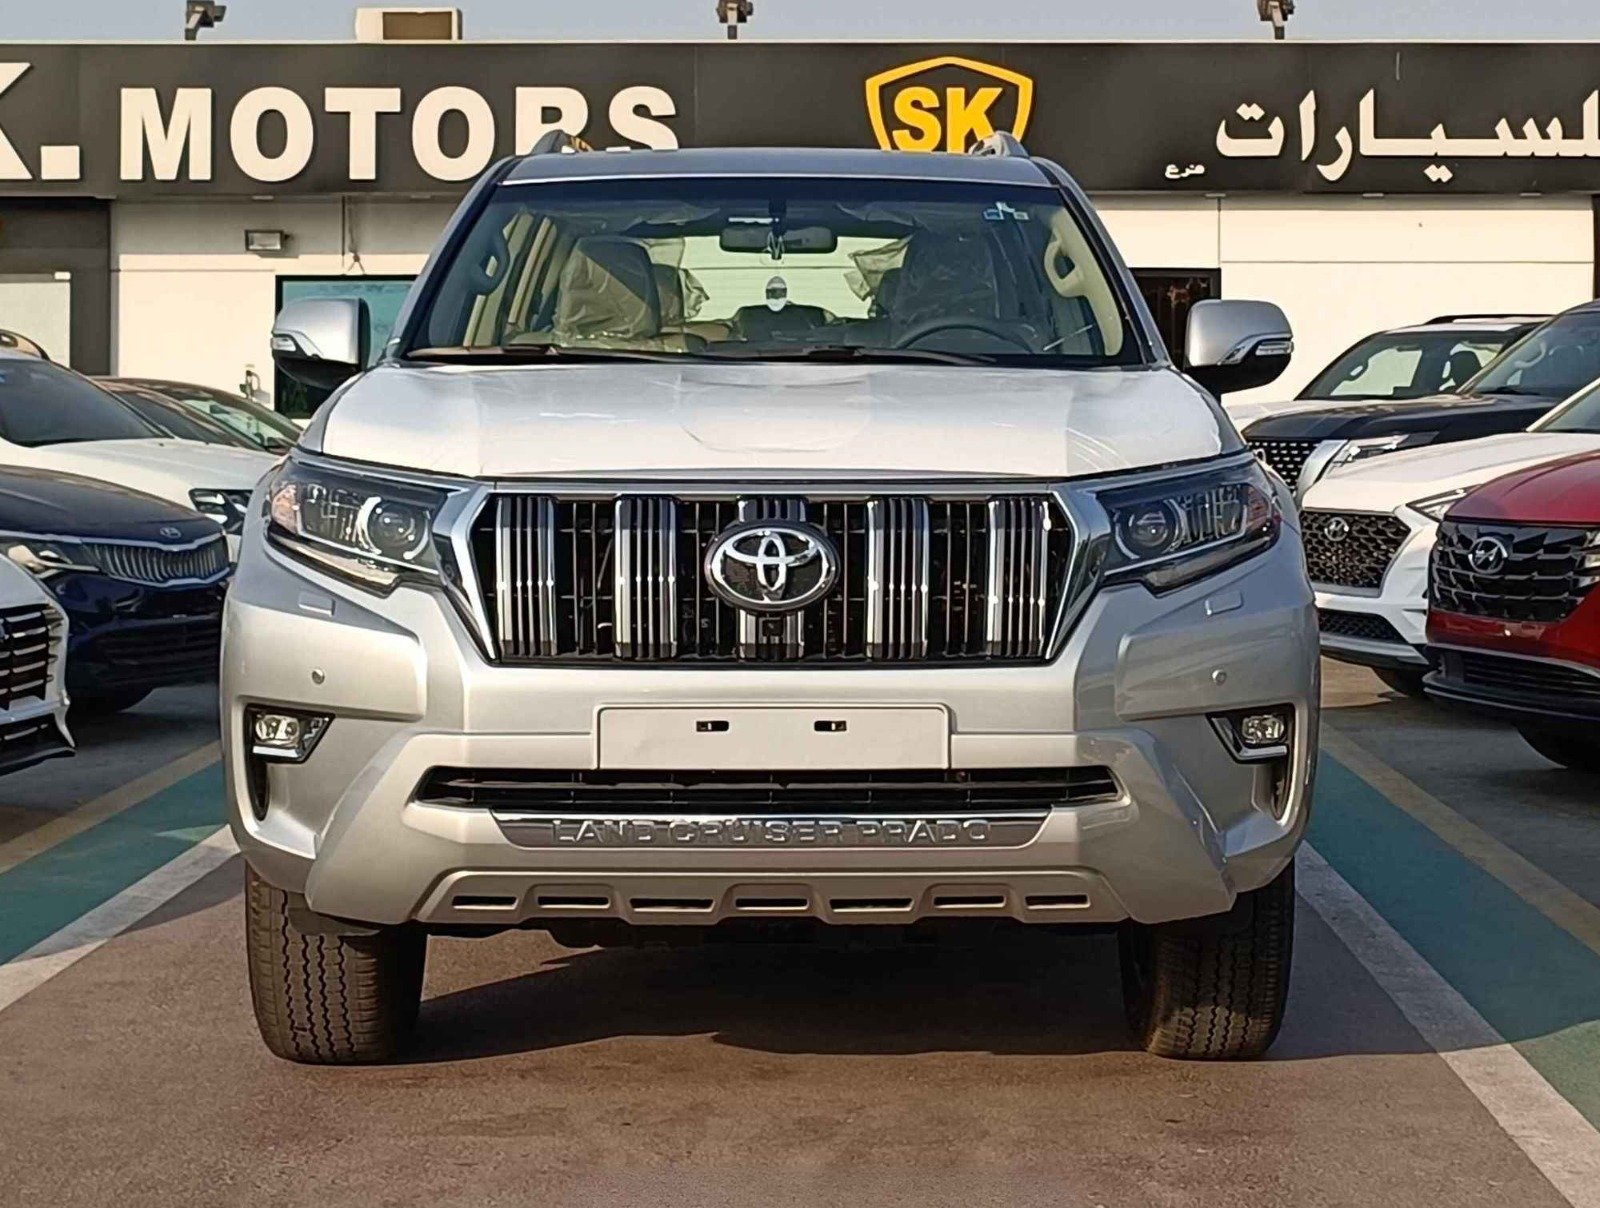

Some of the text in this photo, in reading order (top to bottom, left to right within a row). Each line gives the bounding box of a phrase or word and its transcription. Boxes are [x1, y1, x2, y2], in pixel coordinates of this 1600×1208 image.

[120, 86, 679, 182] MOTORS
[892, 86, 1003, 153] SK
[1216, 88, 1600, 182] لسيارات
[552, 819, 990, 843] LAND CRUISER PRADO
